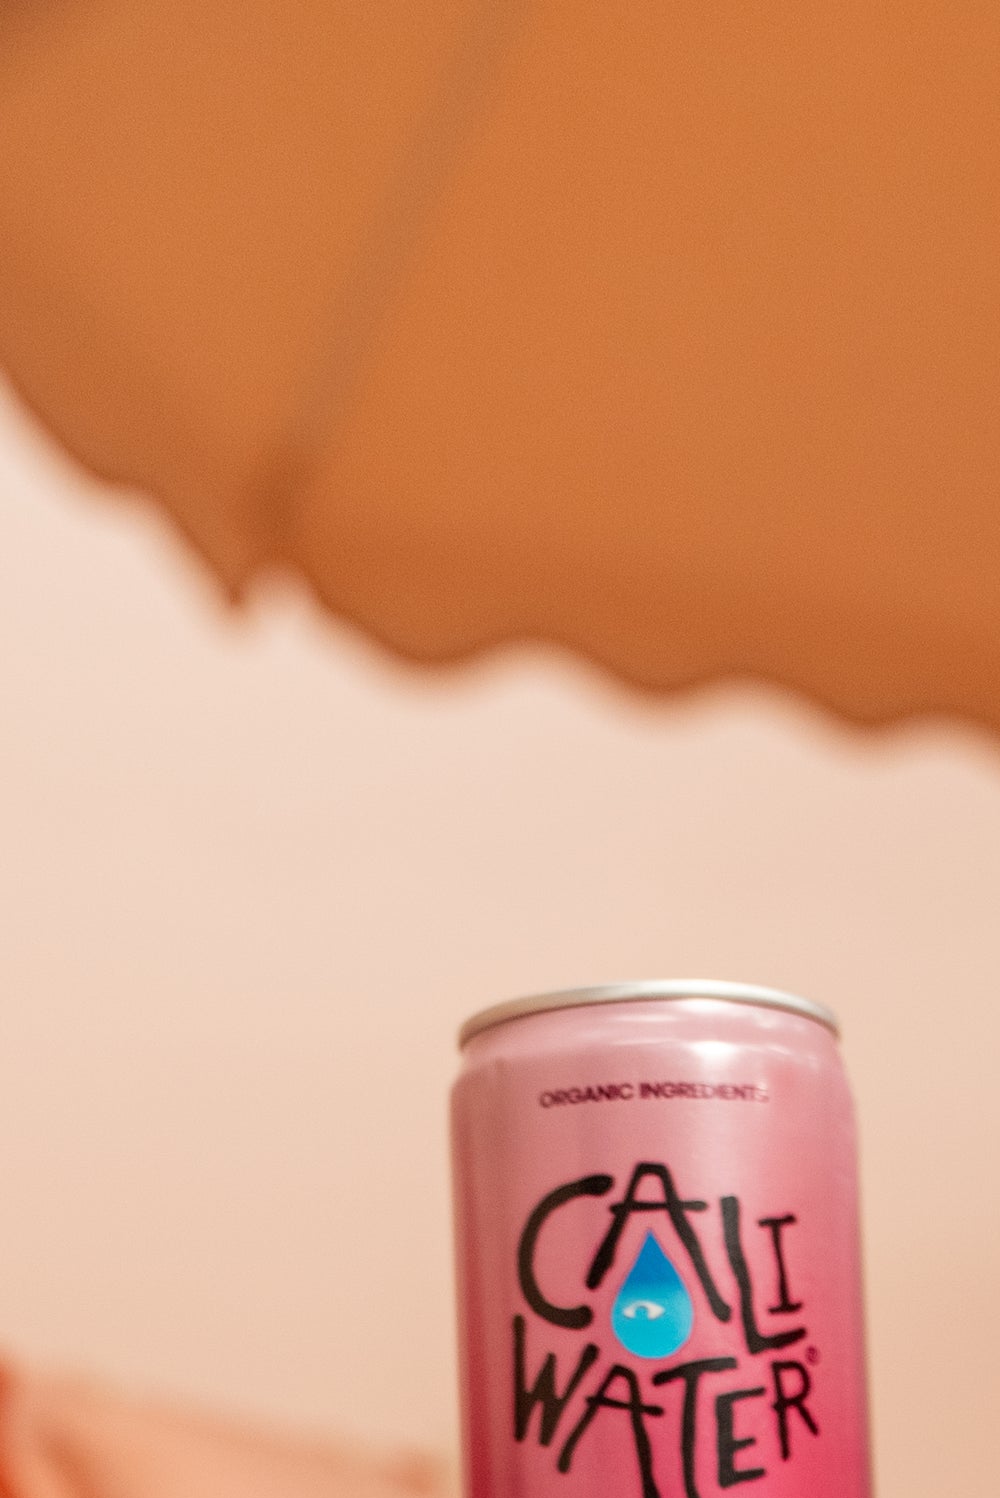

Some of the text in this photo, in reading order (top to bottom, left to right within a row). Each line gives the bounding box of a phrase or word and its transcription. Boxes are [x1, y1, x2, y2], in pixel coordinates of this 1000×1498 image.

[539, 1082, 769, 1109] ORGANIC INGREDIENTS
[518, 1162, 806, 1354] CALI
